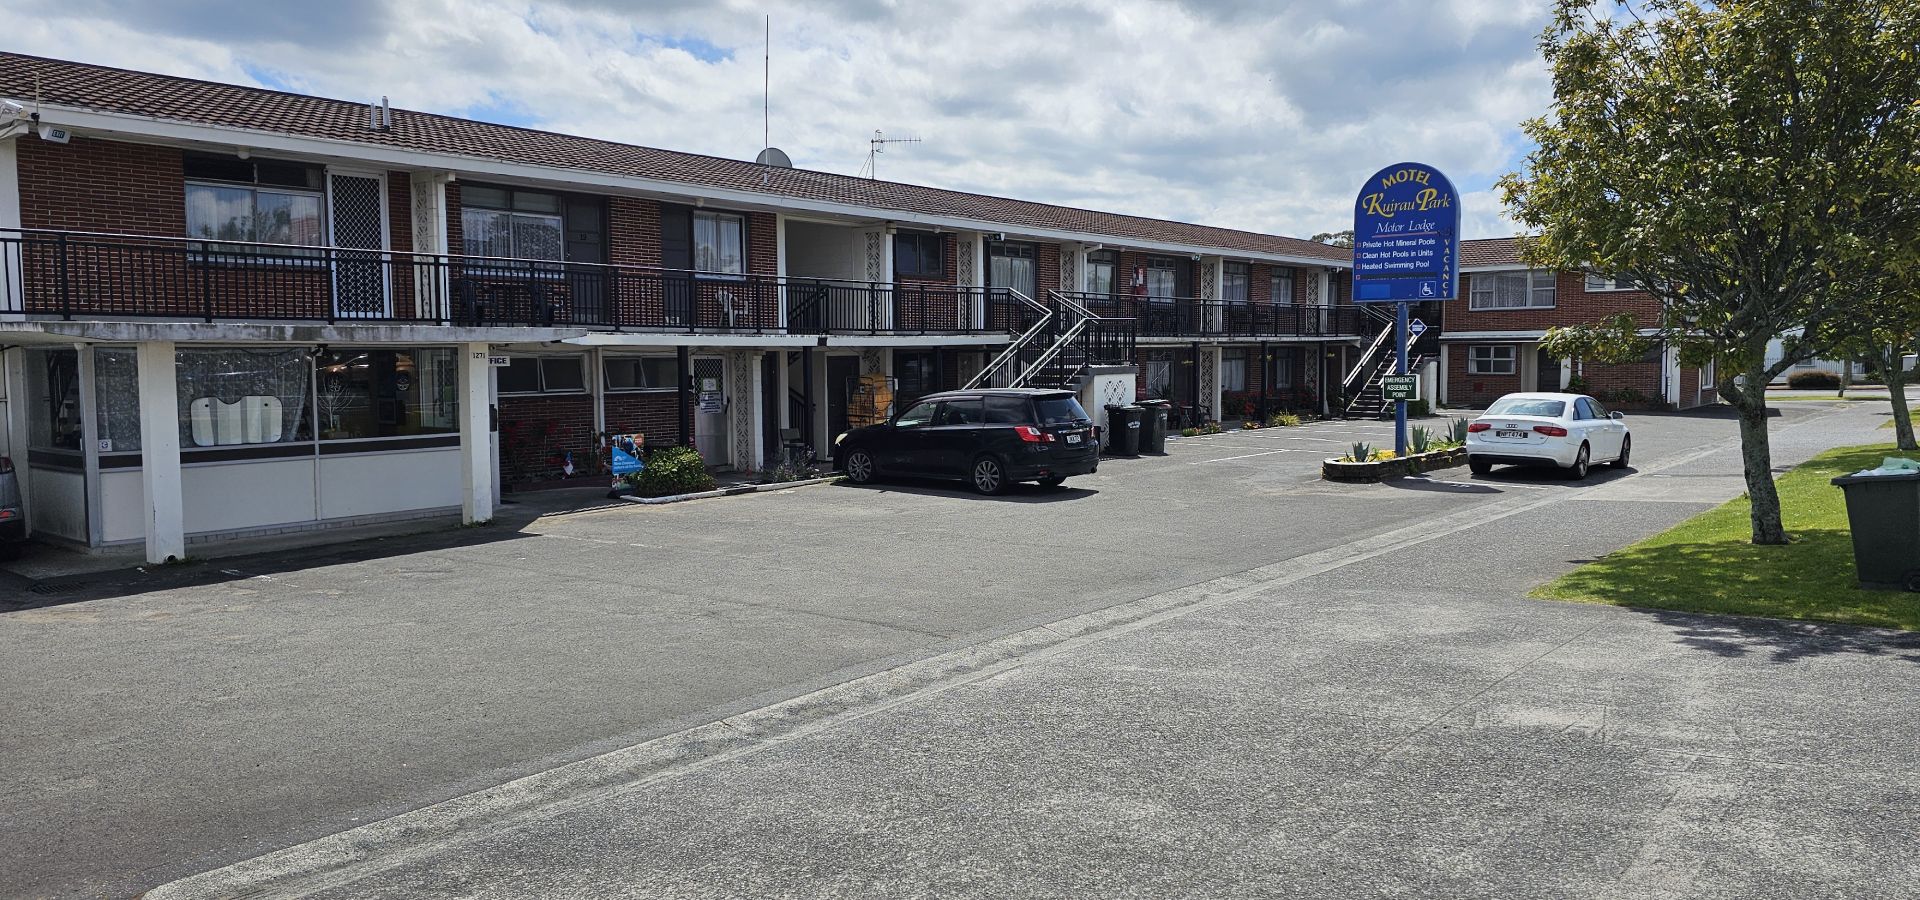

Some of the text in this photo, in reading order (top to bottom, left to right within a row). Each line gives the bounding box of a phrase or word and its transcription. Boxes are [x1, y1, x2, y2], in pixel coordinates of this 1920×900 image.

[1382, 169, 1431, 189] MOTEL
[1362, 188, 1451, 218] Kuirau Park
[1376, 220, 1435, 233] Motor Lodge
[1392, 250, 1410, 258] Pools
[1418, 249, 1434, 257] Units
[1361, 260, 1430, 270] Heated Swimming Pool
[1442, 239, 1451, 297] VACANCY
